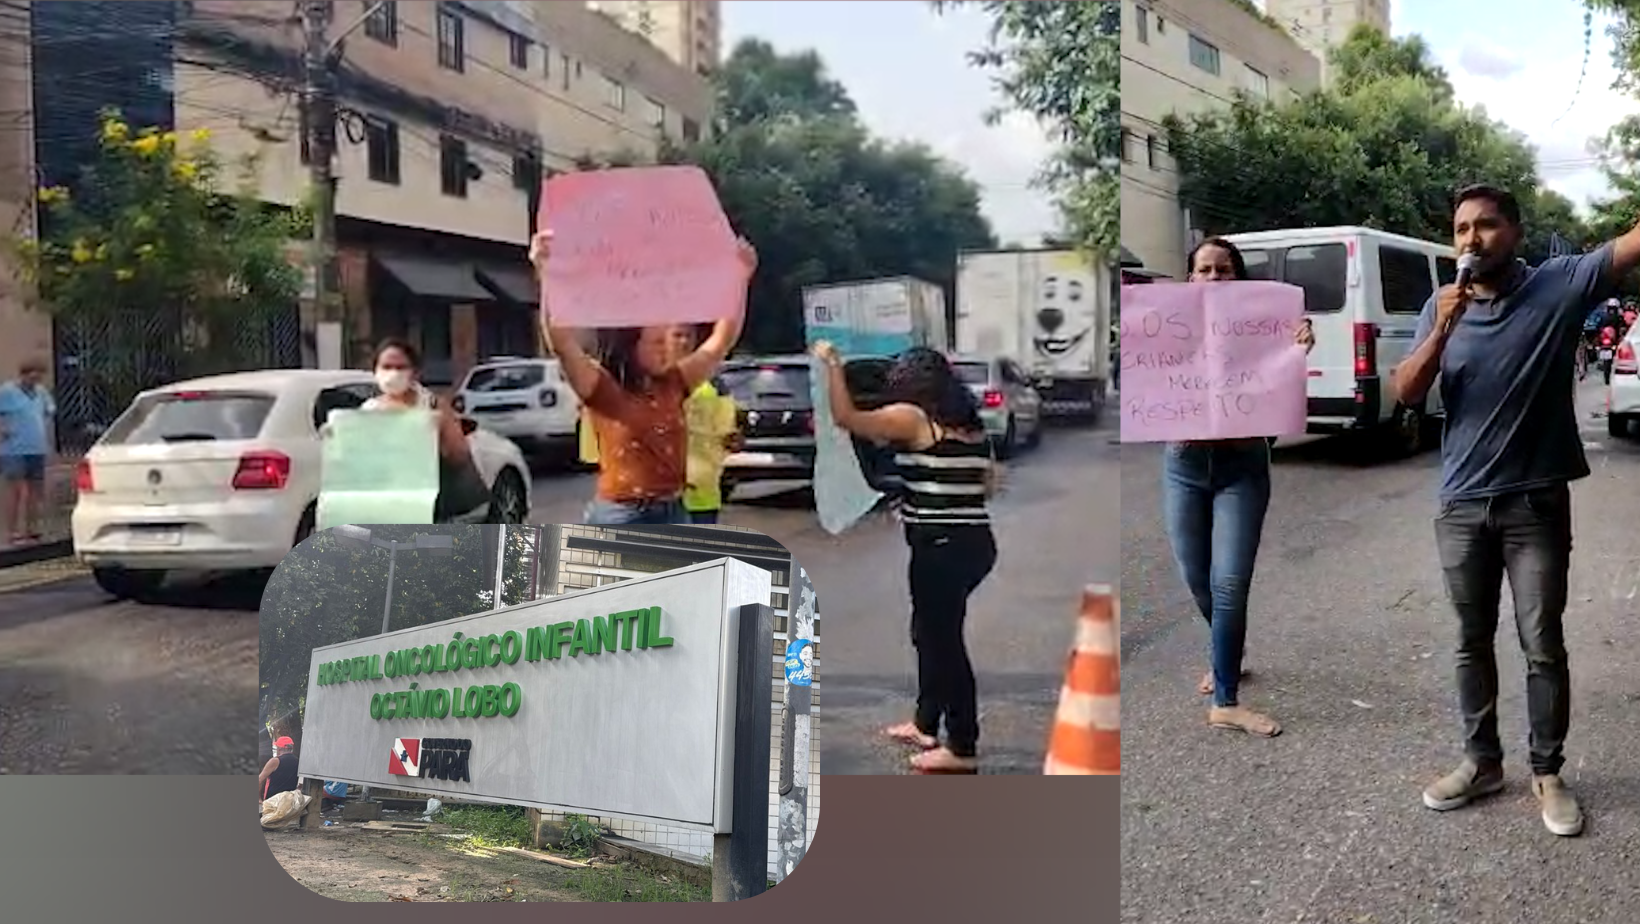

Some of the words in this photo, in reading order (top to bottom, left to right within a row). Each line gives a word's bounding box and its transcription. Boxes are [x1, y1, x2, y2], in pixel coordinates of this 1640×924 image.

[316, 654, 383, 687] HOSPITAL
[384, 630, 522, 679] ONCOLÓGICO
[524, 605, 674, 663] INFANTIL
[370, 681, 450, 721] OCTÁVIO
[451, 681, 522, 718] LOBO
